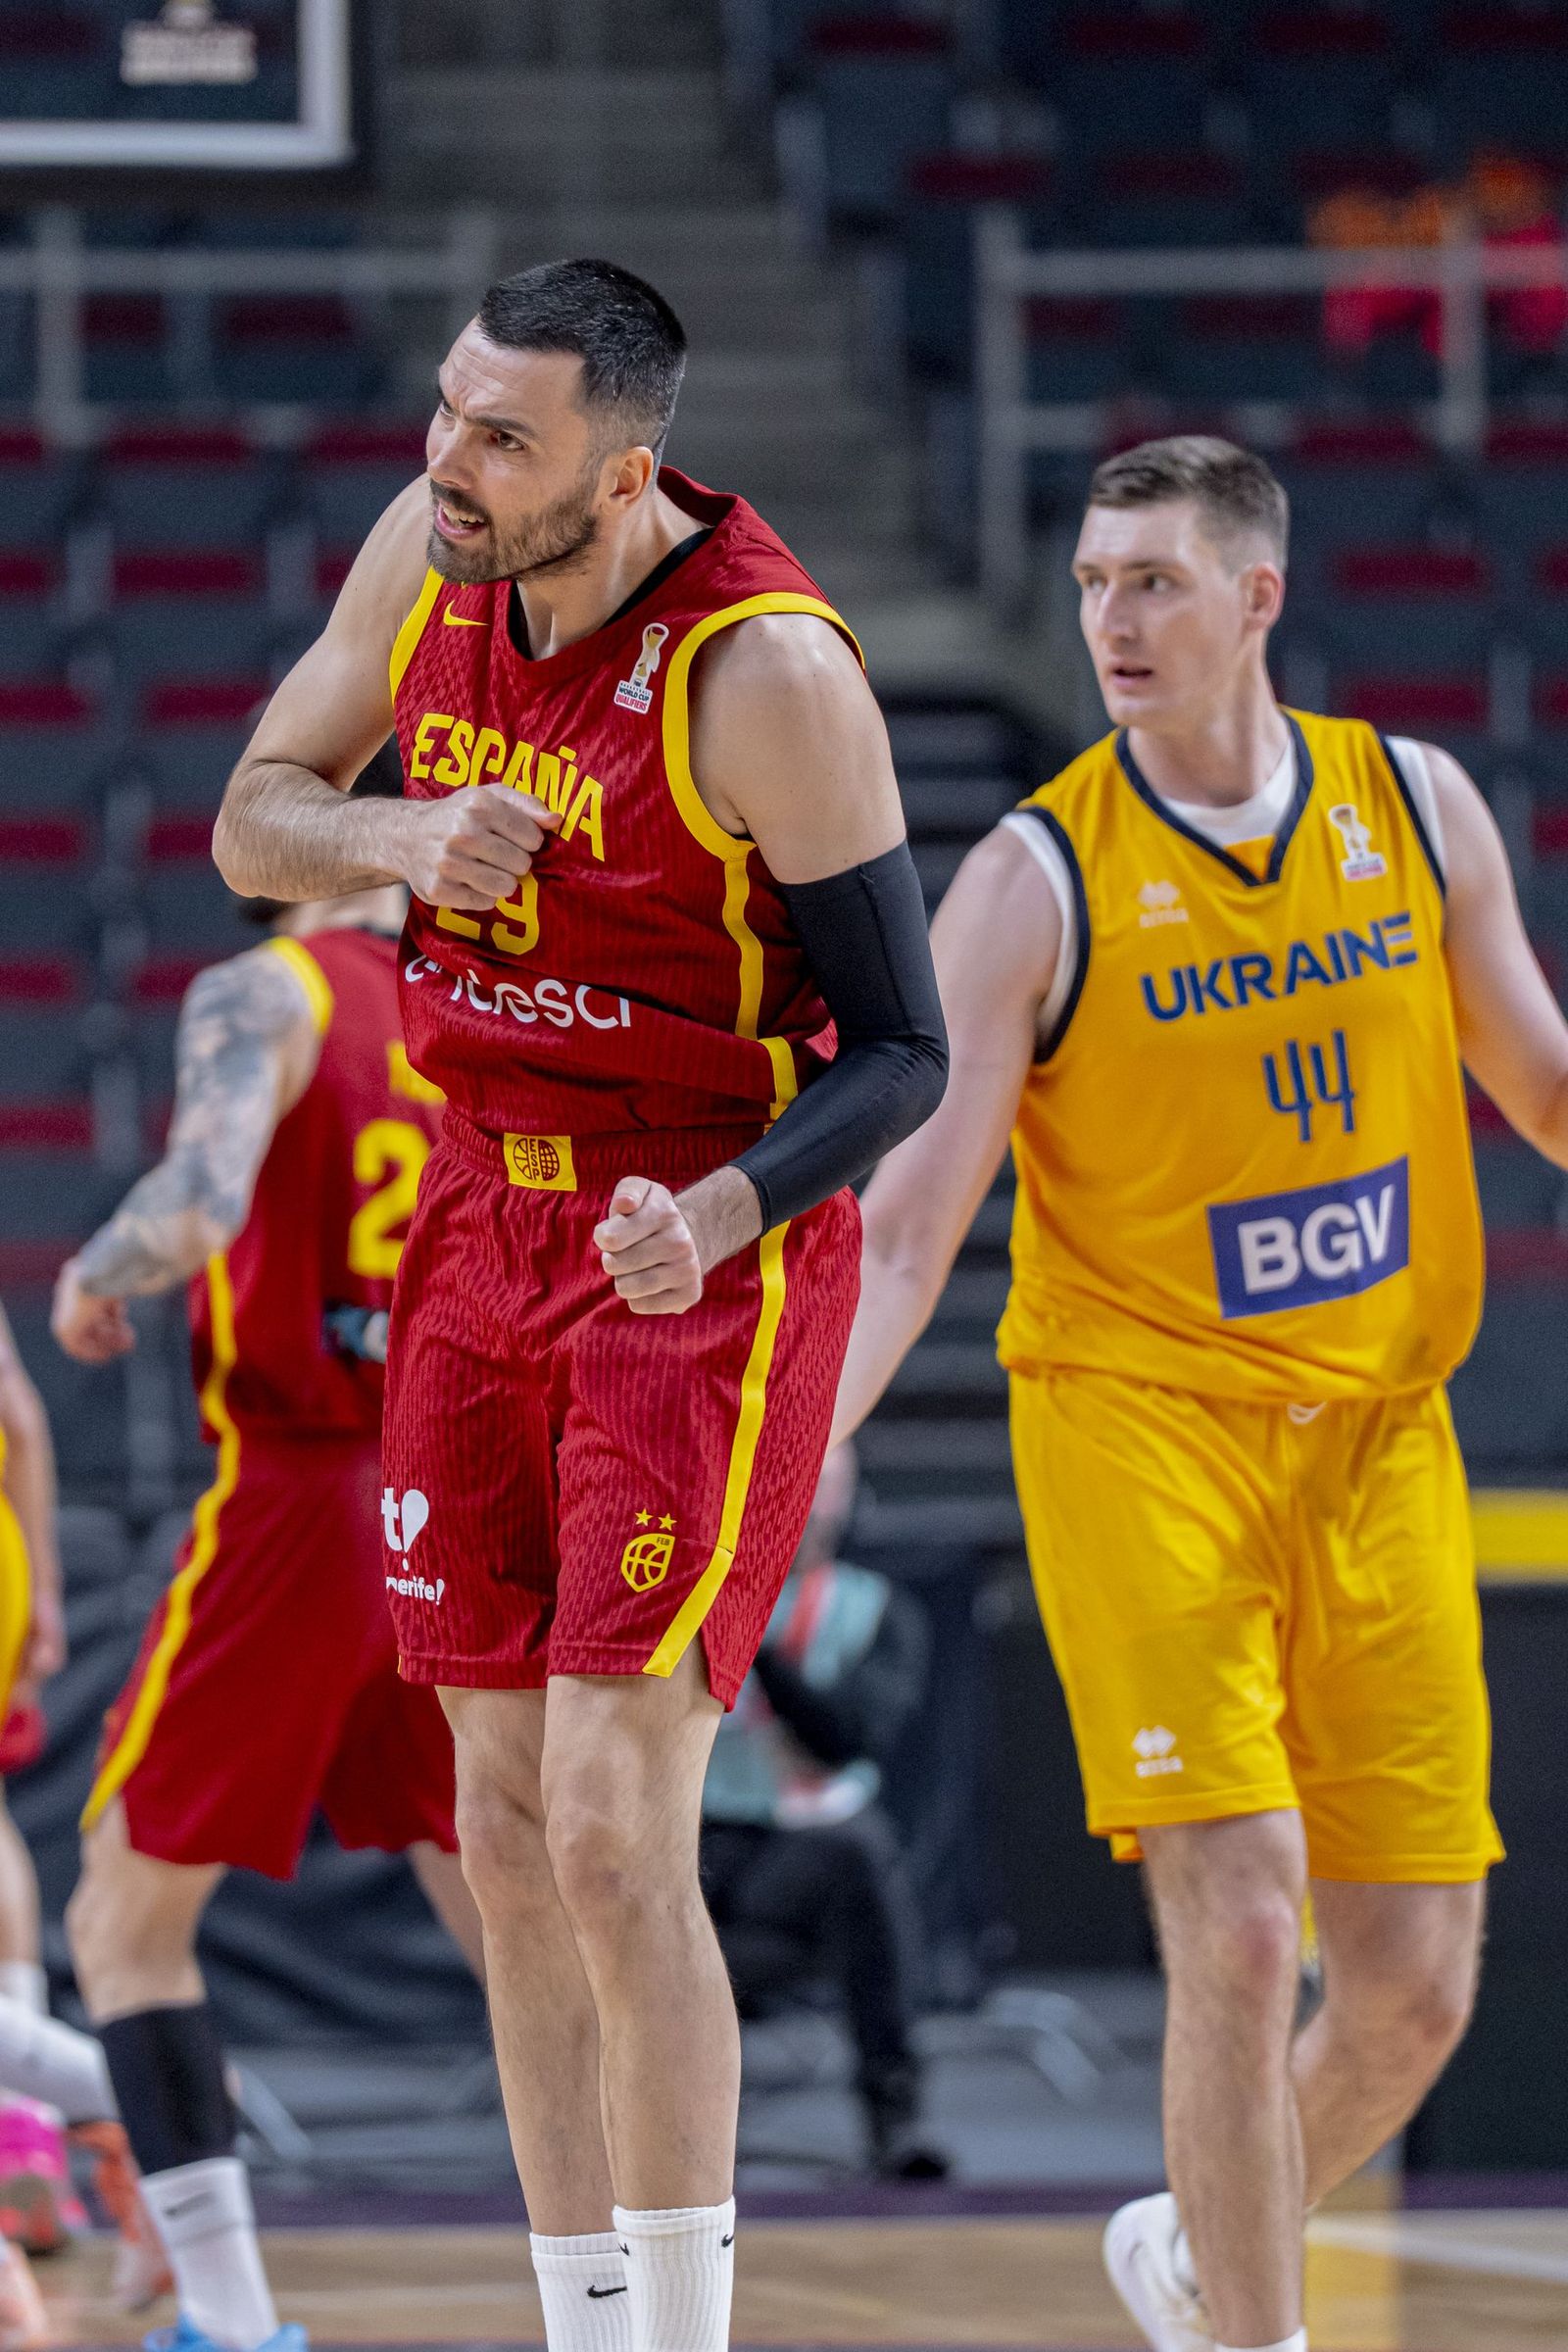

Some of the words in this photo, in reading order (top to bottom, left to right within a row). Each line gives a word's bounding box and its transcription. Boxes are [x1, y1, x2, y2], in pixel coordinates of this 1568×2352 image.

[411, 712, 605, 861] ESPAÑA
[1141, 911, 1418, 1021] UKRAINE
[1261, 1028, 1355, 1144] 44
[1238, 1183, 1396, 1296] BGV
